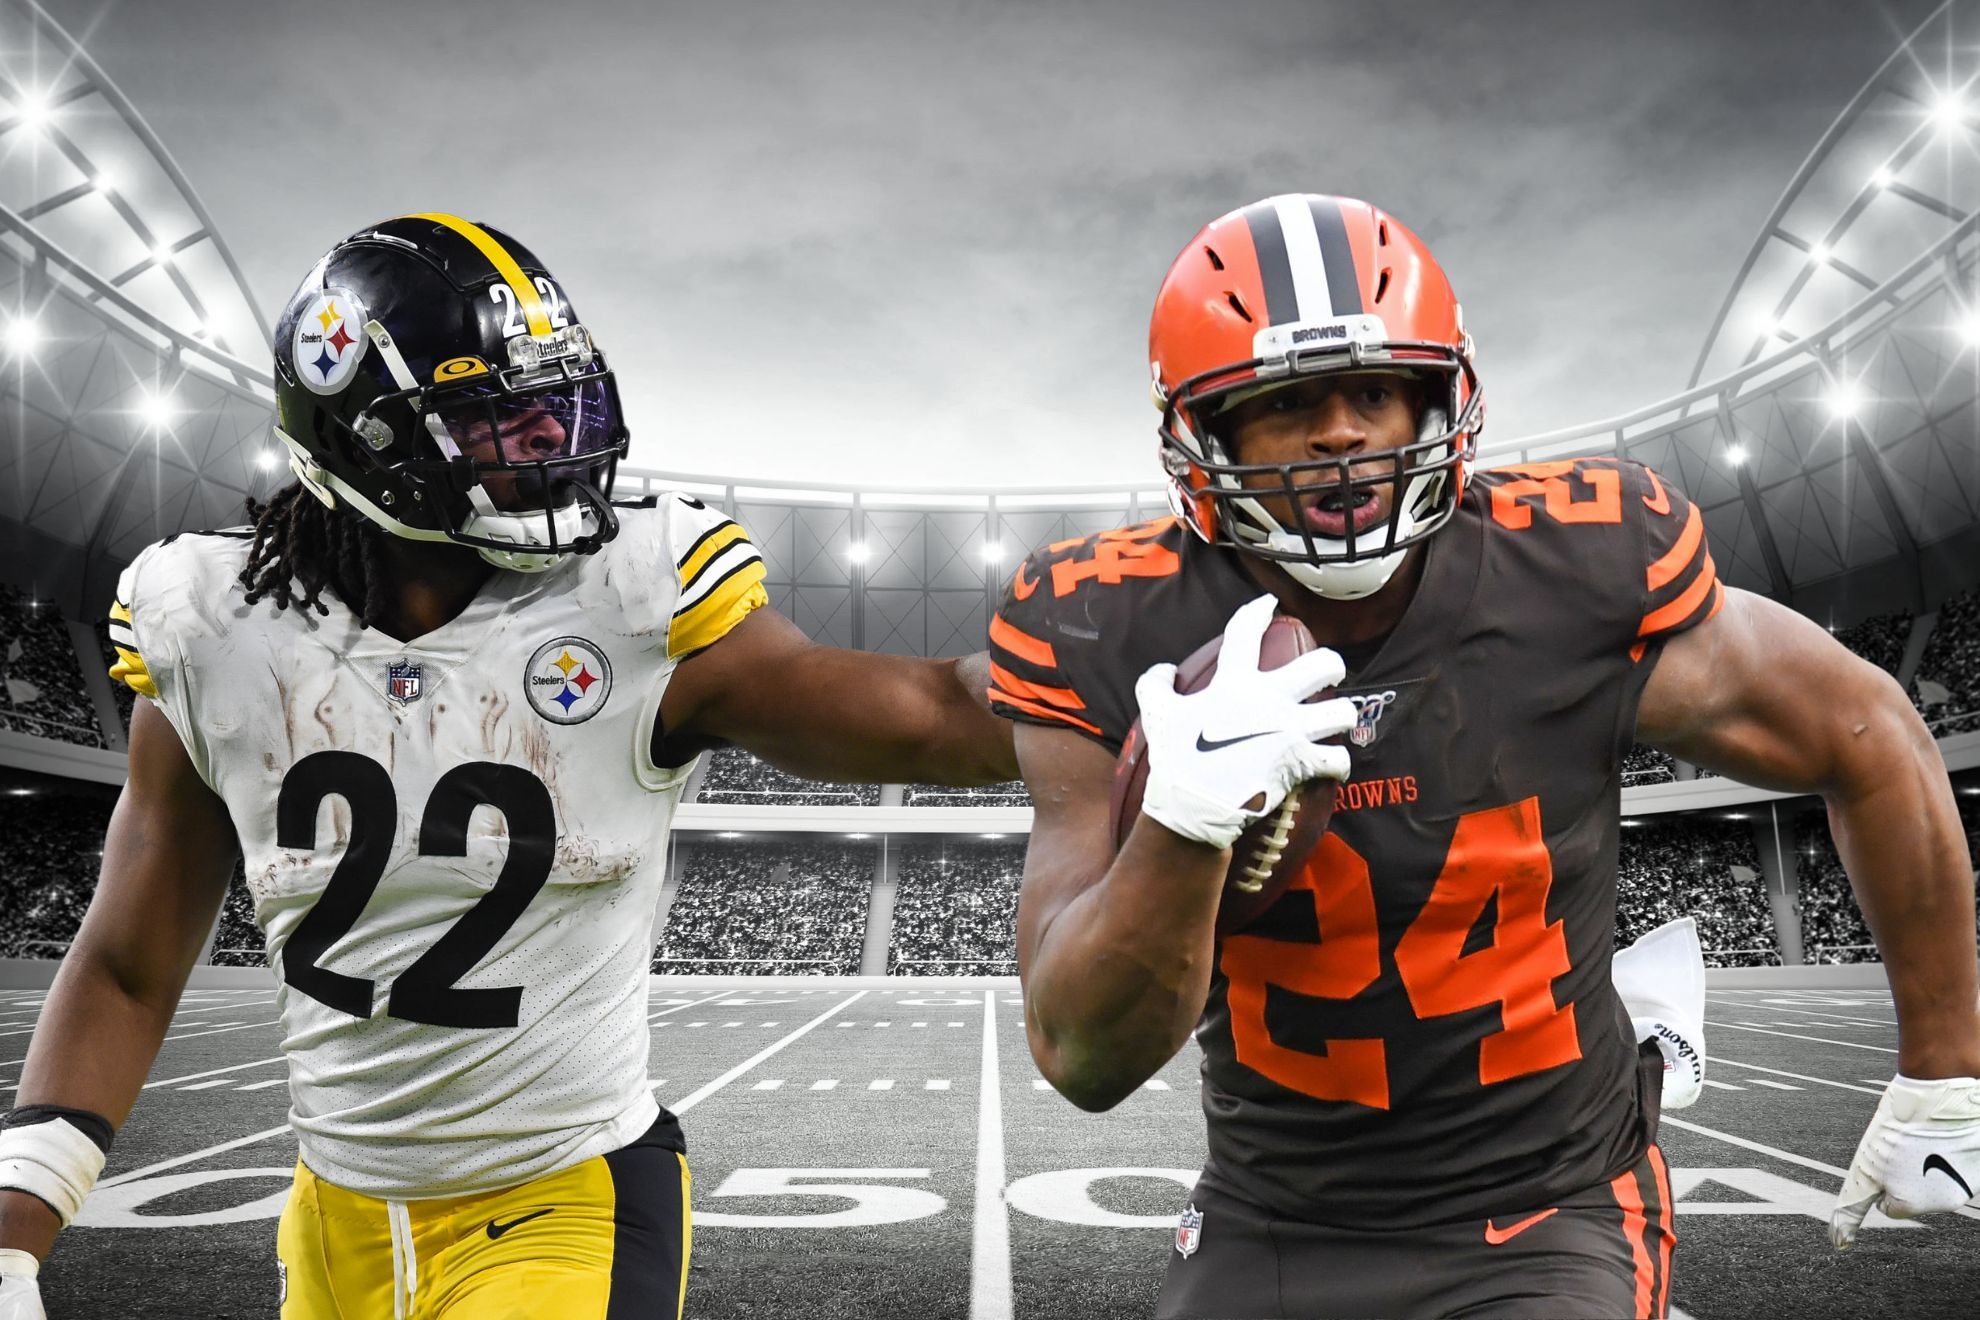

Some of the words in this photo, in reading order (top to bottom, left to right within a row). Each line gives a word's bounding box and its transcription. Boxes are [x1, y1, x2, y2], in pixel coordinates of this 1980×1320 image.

[301, 332, 322, 343] Steelers
[1292, 325, 1347, 344] BROWNS
[391, 679, 418, 697] NFL
[532, 675, 565, 686] Steelers
[1333, 776, 1418, 812] ROWNS
[277, 750, 556, 1029] 22
[1221, 797, 1582, 1109] 24
